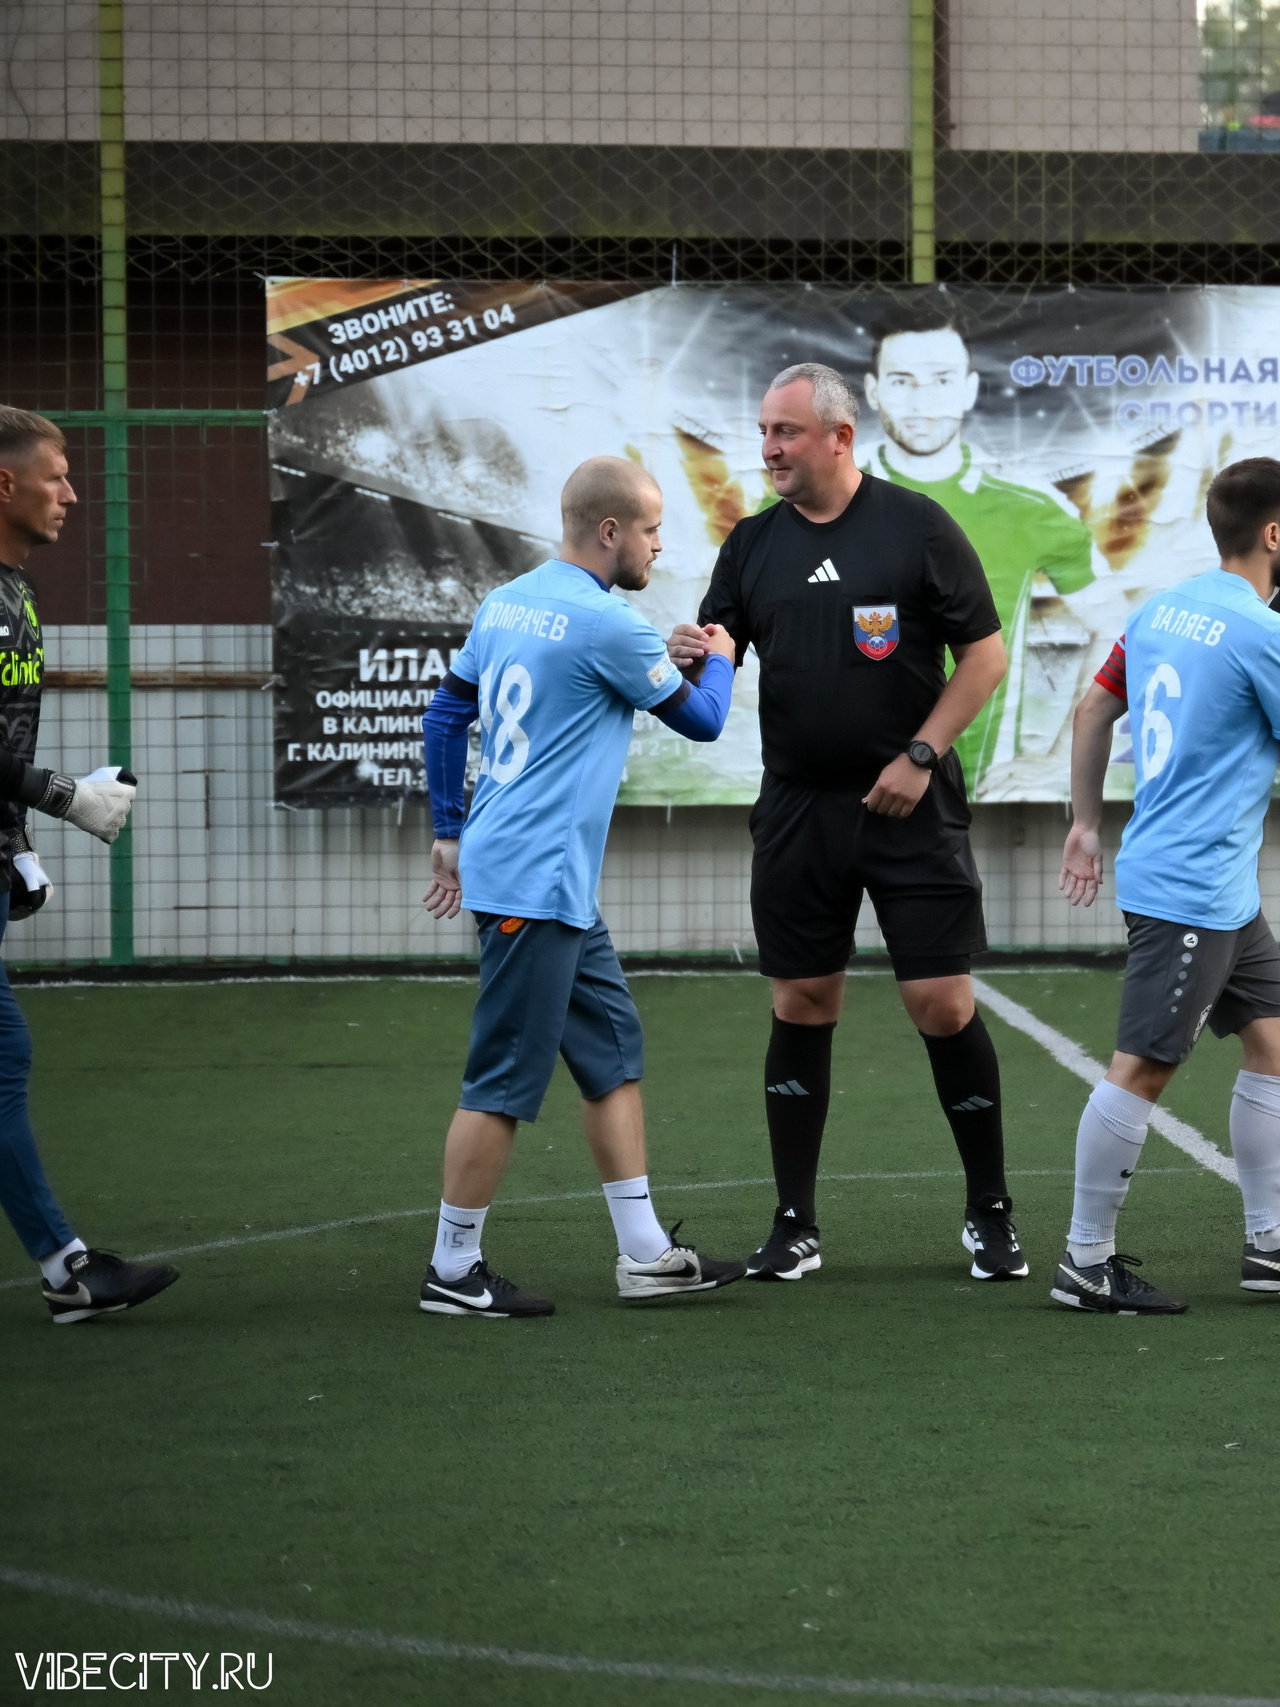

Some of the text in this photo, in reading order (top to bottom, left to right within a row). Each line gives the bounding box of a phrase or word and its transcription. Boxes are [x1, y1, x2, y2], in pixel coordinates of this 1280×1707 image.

[327, 291, 456, 346] ЗВОНИТЕ:
[293, 303, 516, 388] +7 (4012) 93 31 04
[1009, 354, 1279, 387] ФУТБОЛЬНАЯ
[480, 601, 569, 642] ДОМРАЧЕВ
[1151, 605, 1226, 647] ВАЛЯЕВ
[323, 716, 424, 734] В КАЛИН
[1141, 663, 1181, 782] 6
[288, 743, 425, 761] Г. КАЛИНИНГ
[443, 1230, 465, 1248] 15
